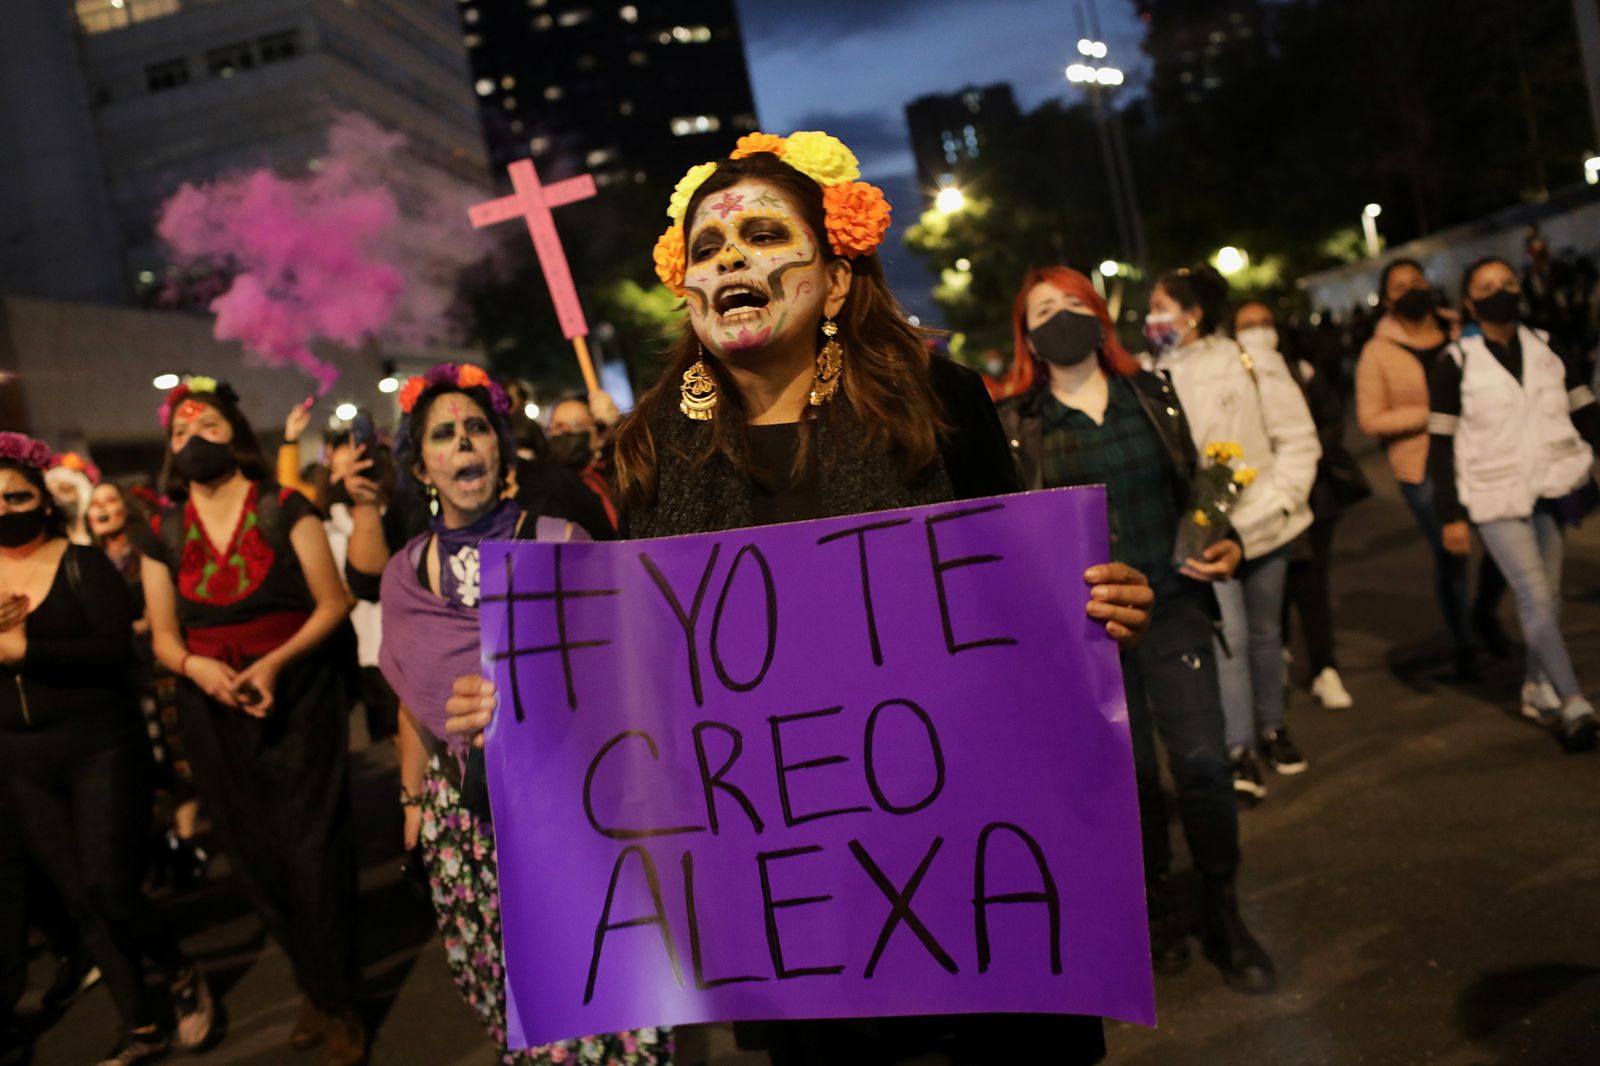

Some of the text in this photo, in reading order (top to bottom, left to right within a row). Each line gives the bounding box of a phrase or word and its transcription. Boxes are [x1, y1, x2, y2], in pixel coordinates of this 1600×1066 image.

[480, 503, 1019, 723] #YO TE
[582, 697, 946, 839] CREO
[583, 821, 1064, 1006] ALEXA
